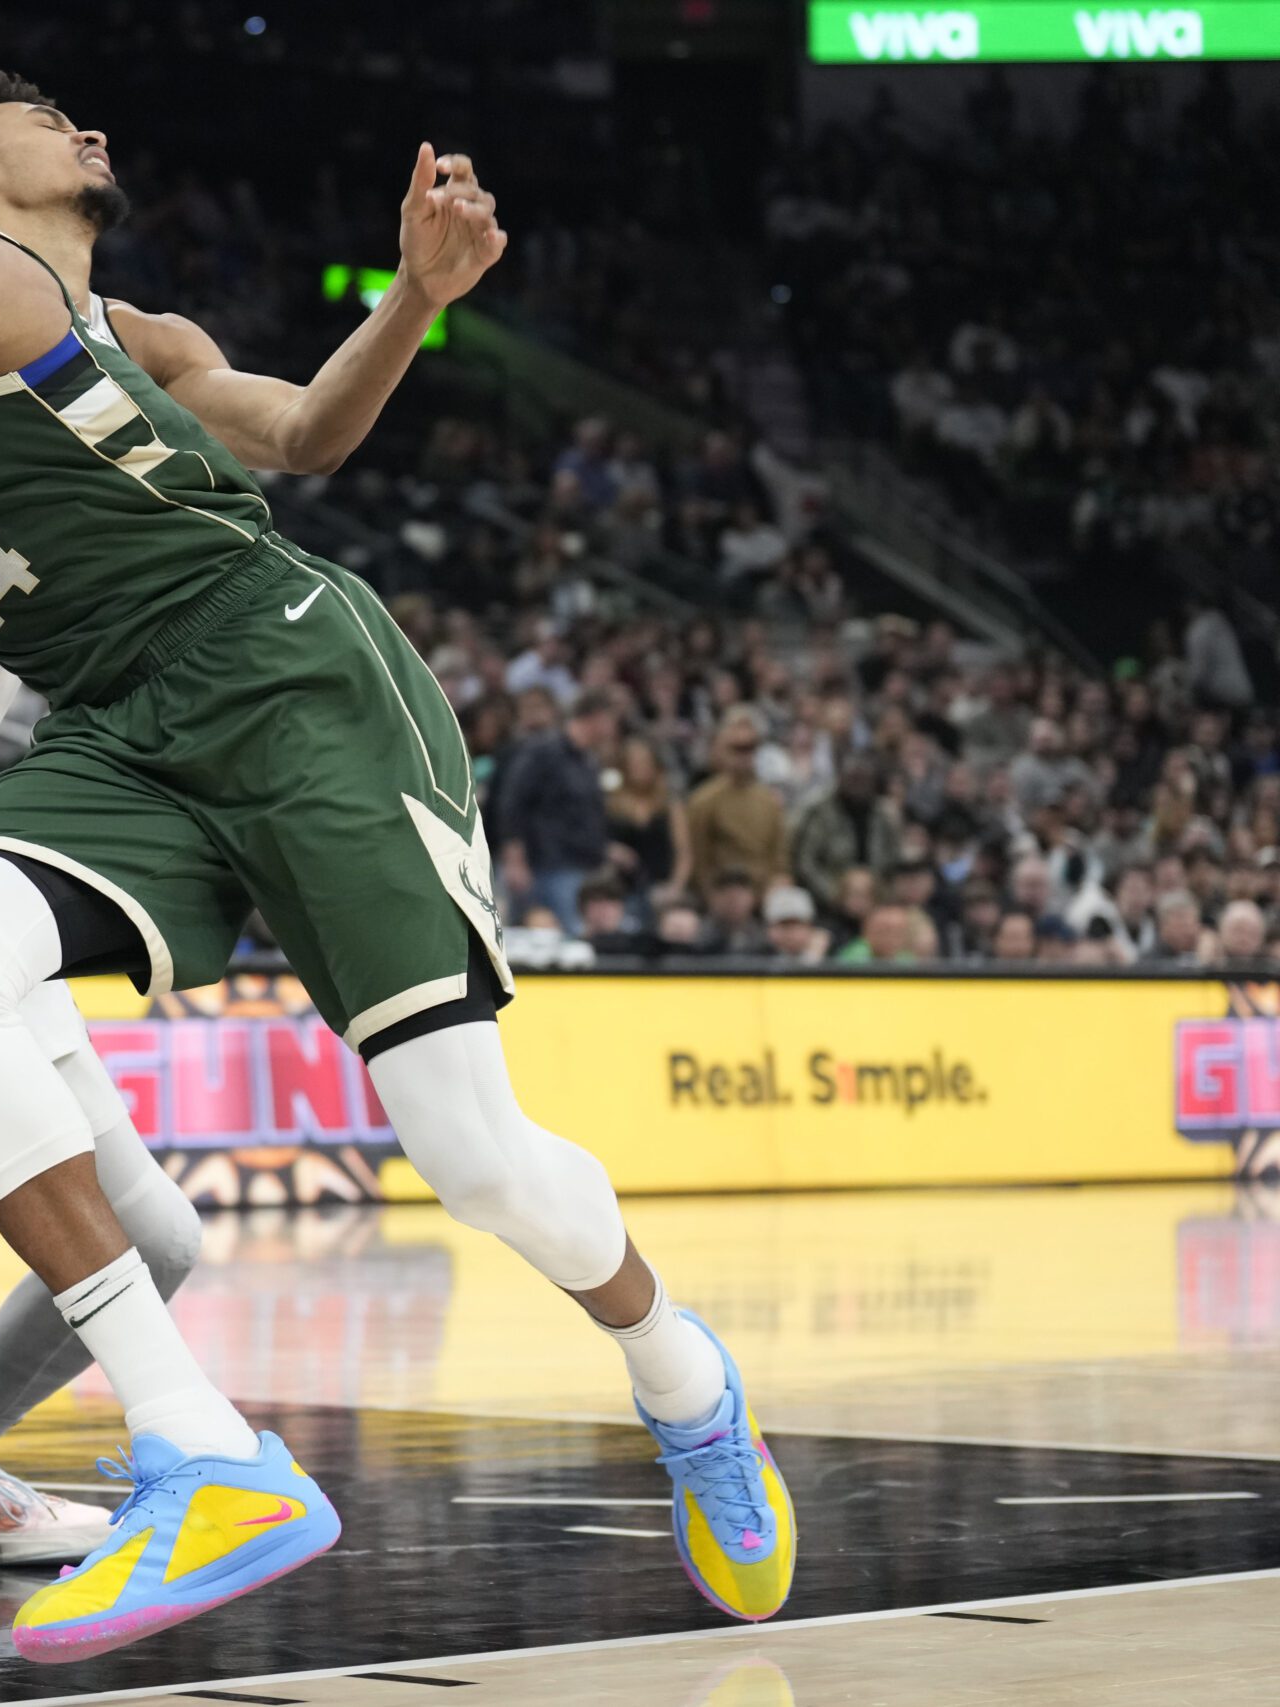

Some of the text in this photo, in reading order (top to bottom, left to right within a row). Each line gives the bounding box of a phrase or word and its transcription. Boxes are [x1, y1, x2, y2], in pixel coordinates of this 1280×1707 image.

[85, 1018, 397, 1150] GUN
[669, 1046, 988, 1117] Real. Simple.
